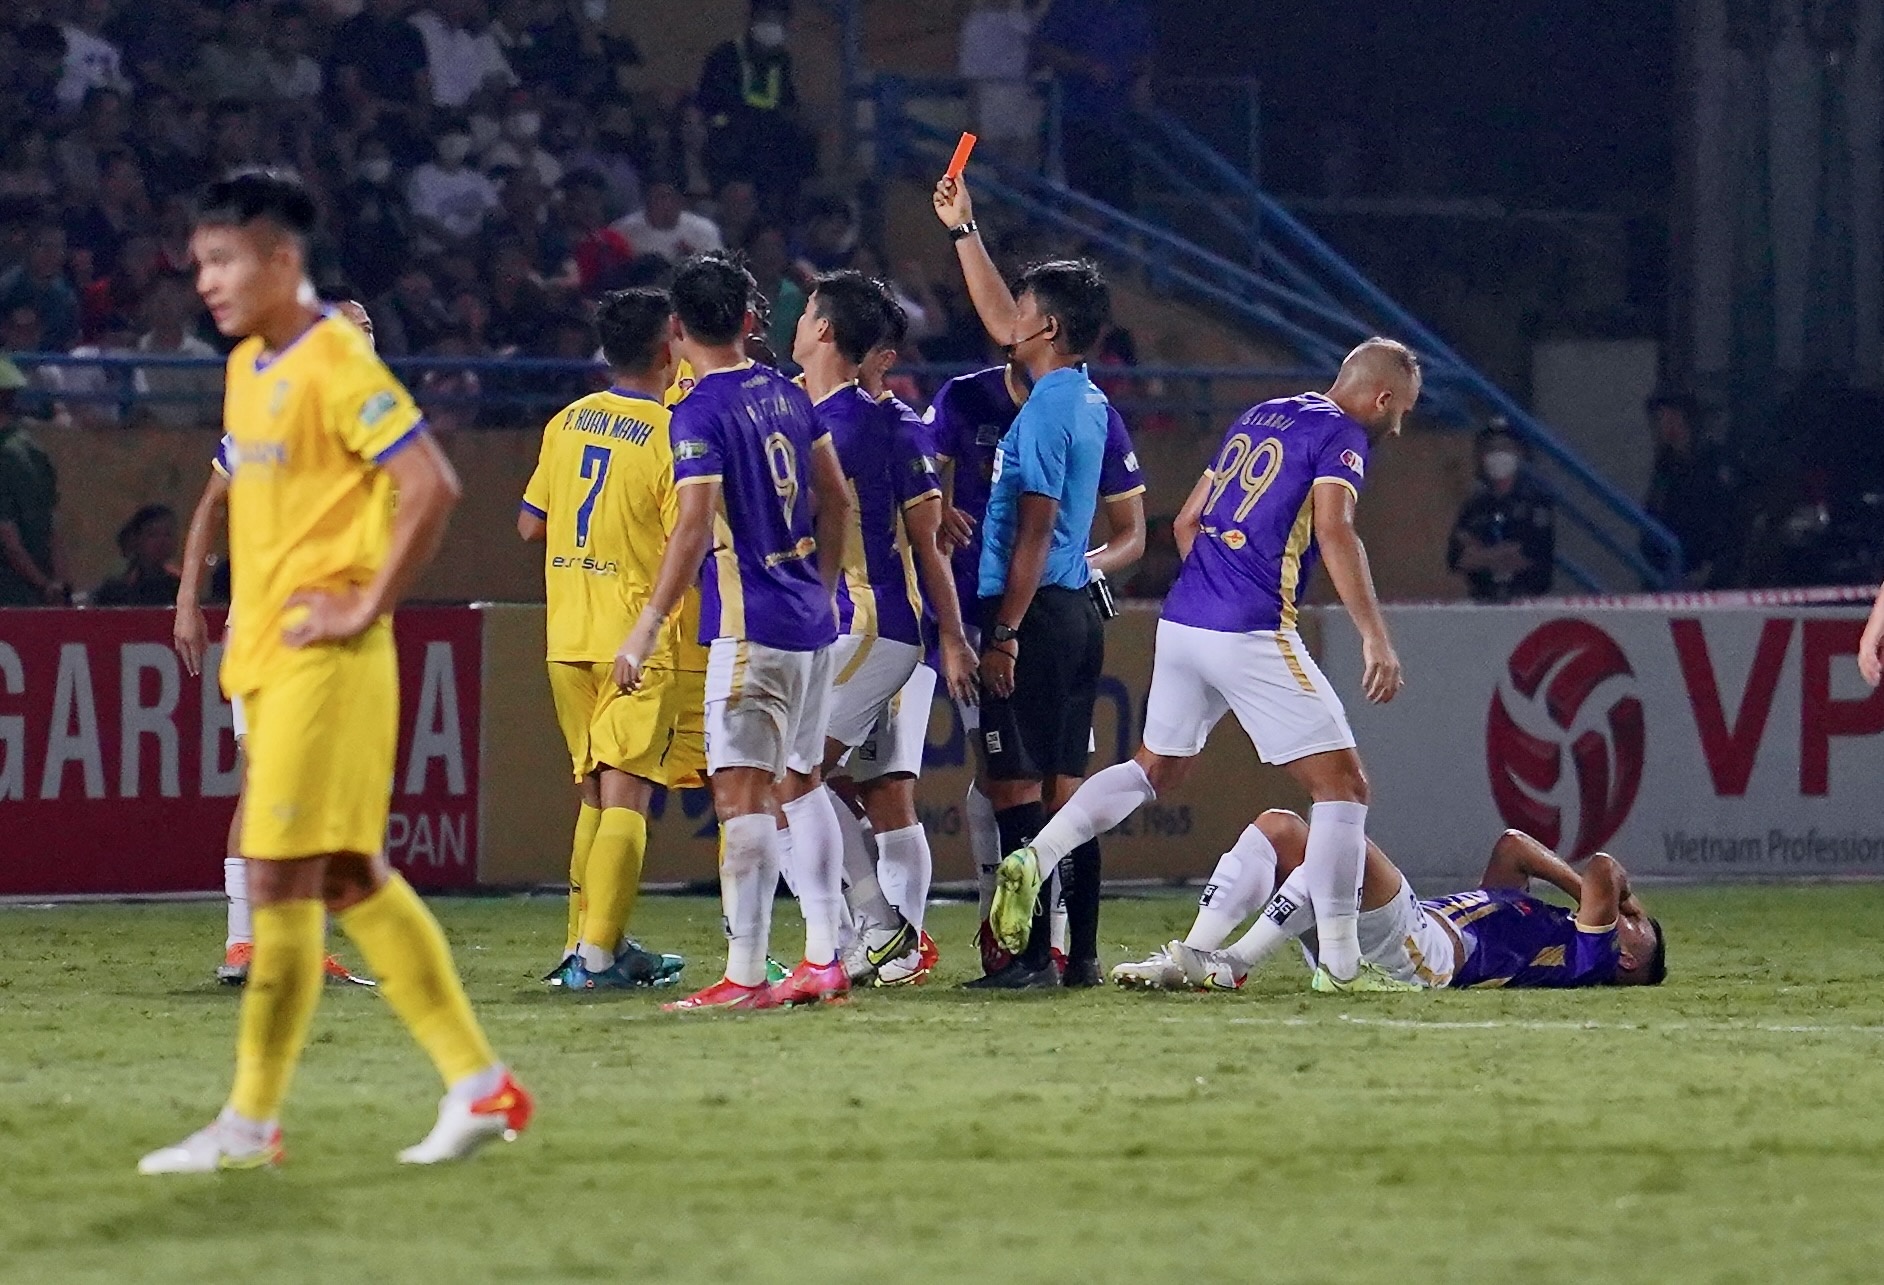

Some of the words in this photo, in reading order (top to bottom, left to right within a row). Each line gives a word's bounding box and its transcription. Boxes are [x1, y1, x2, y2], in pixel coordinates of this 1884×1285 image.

[576, 444, 612, 548] 7
[765, 431, 798, 531] 9
[1203, 433, 1284, 523] 99
[385, 813, 467, 866] PAN
[1662, 832, 1762, 864] Vietnam
